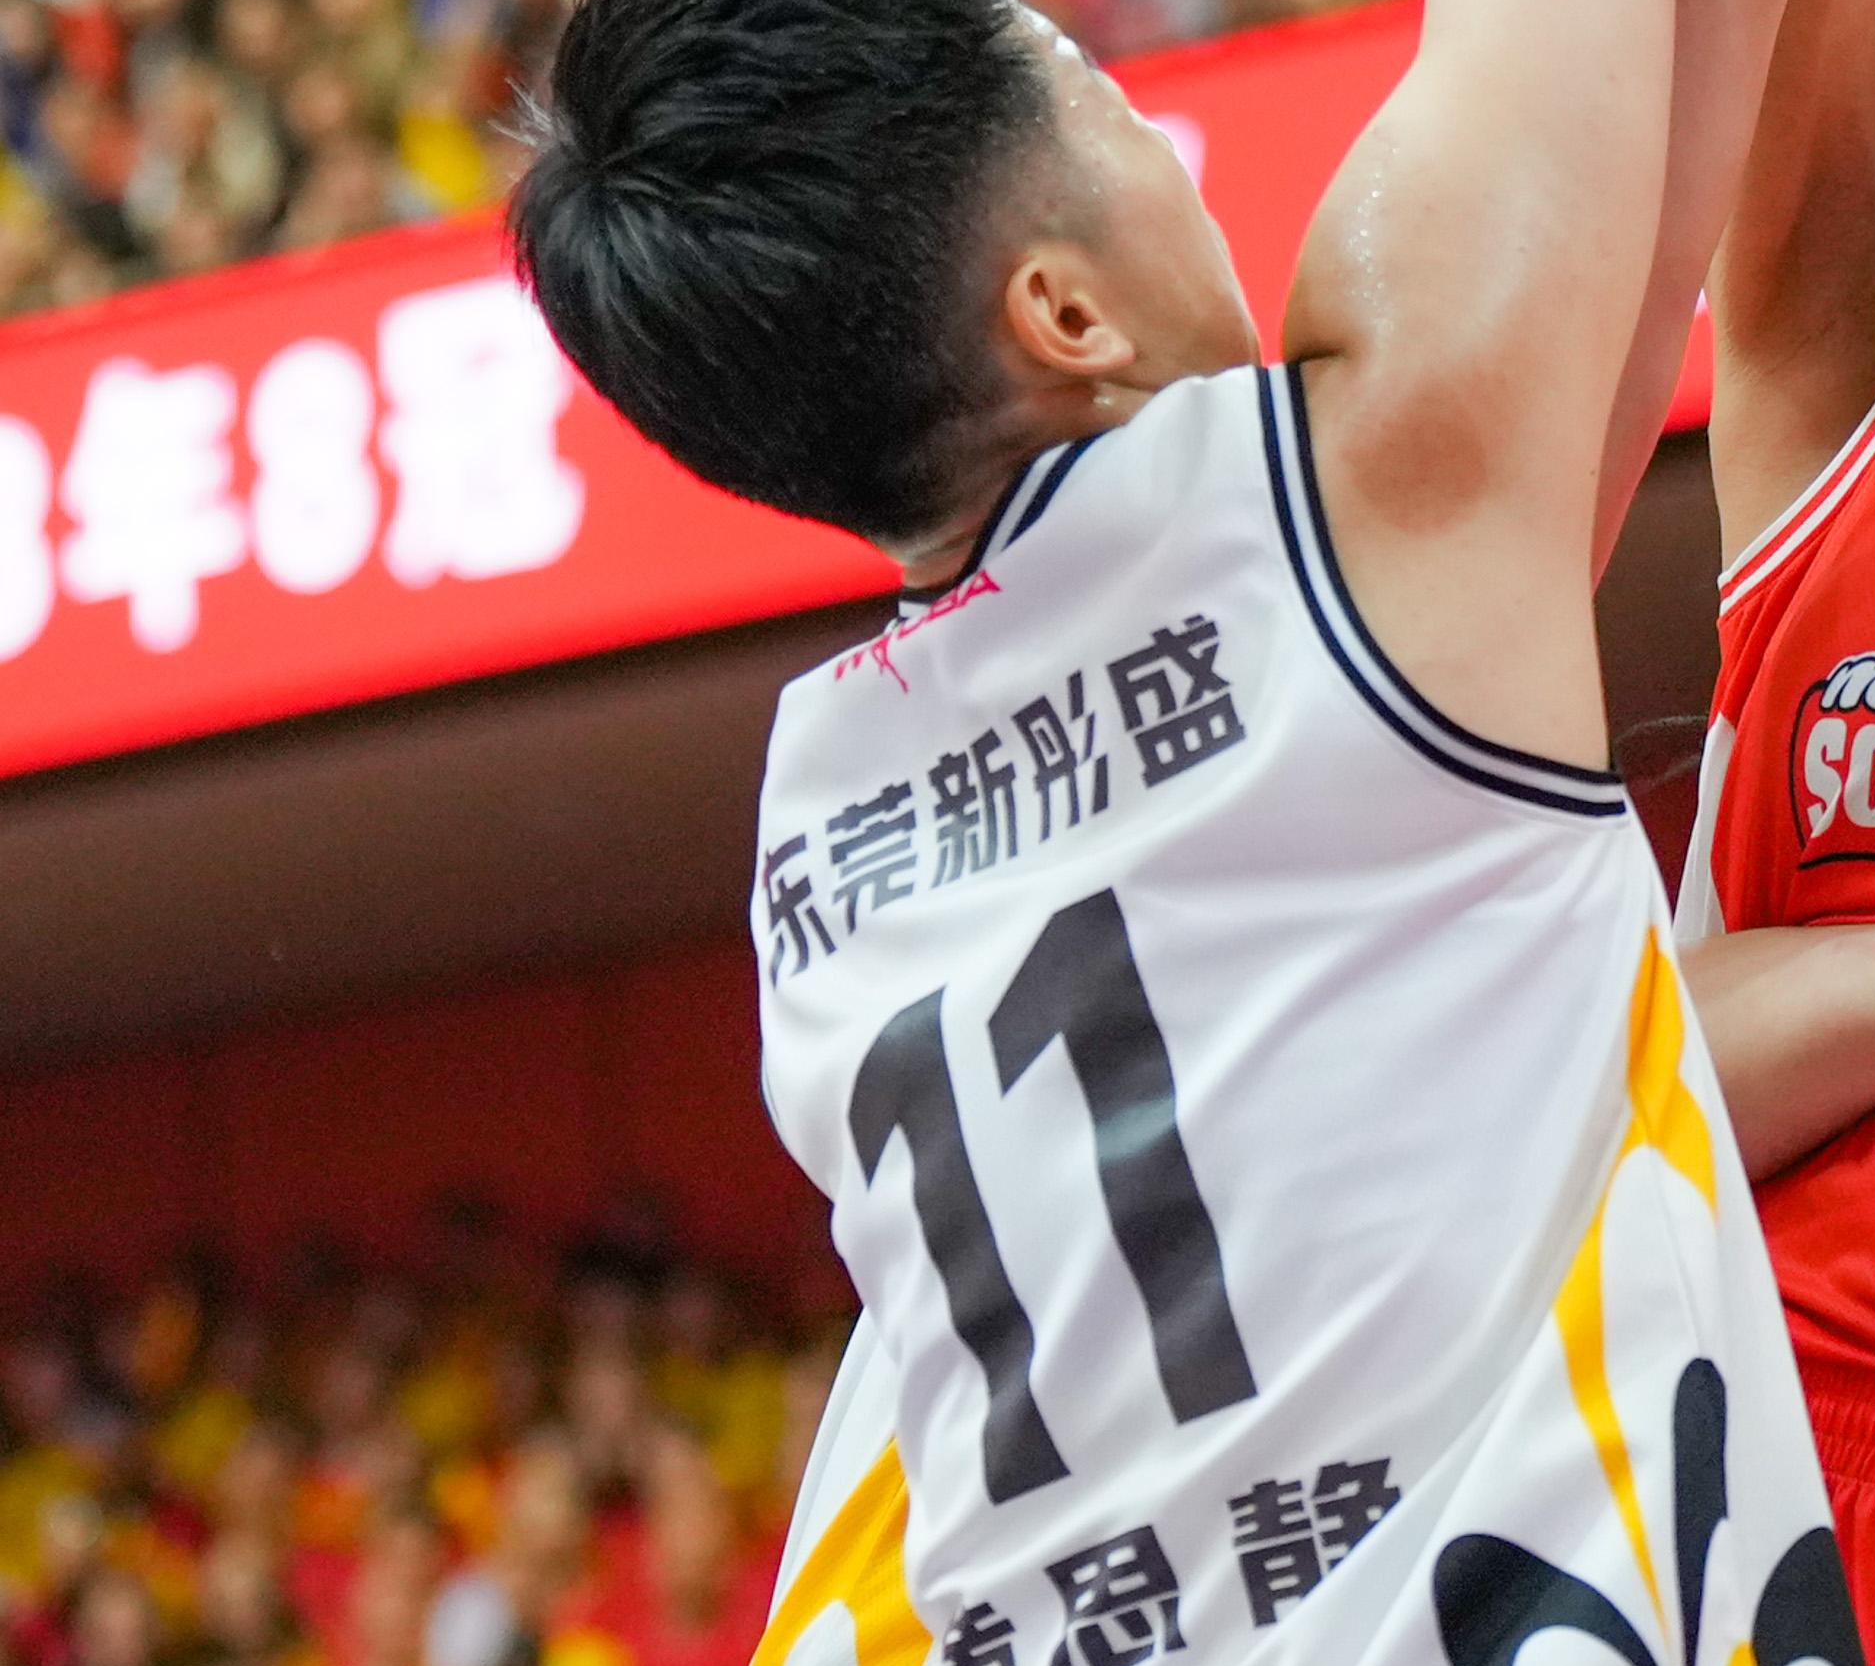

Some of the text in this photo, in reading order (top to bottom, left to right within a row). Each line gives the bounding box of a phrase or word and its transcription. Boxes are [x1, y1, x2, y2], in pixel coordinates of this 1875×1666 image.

[763, 612, 1247, 990] 东莞新彤盛
[847, 886, 1260, 1507] 11
